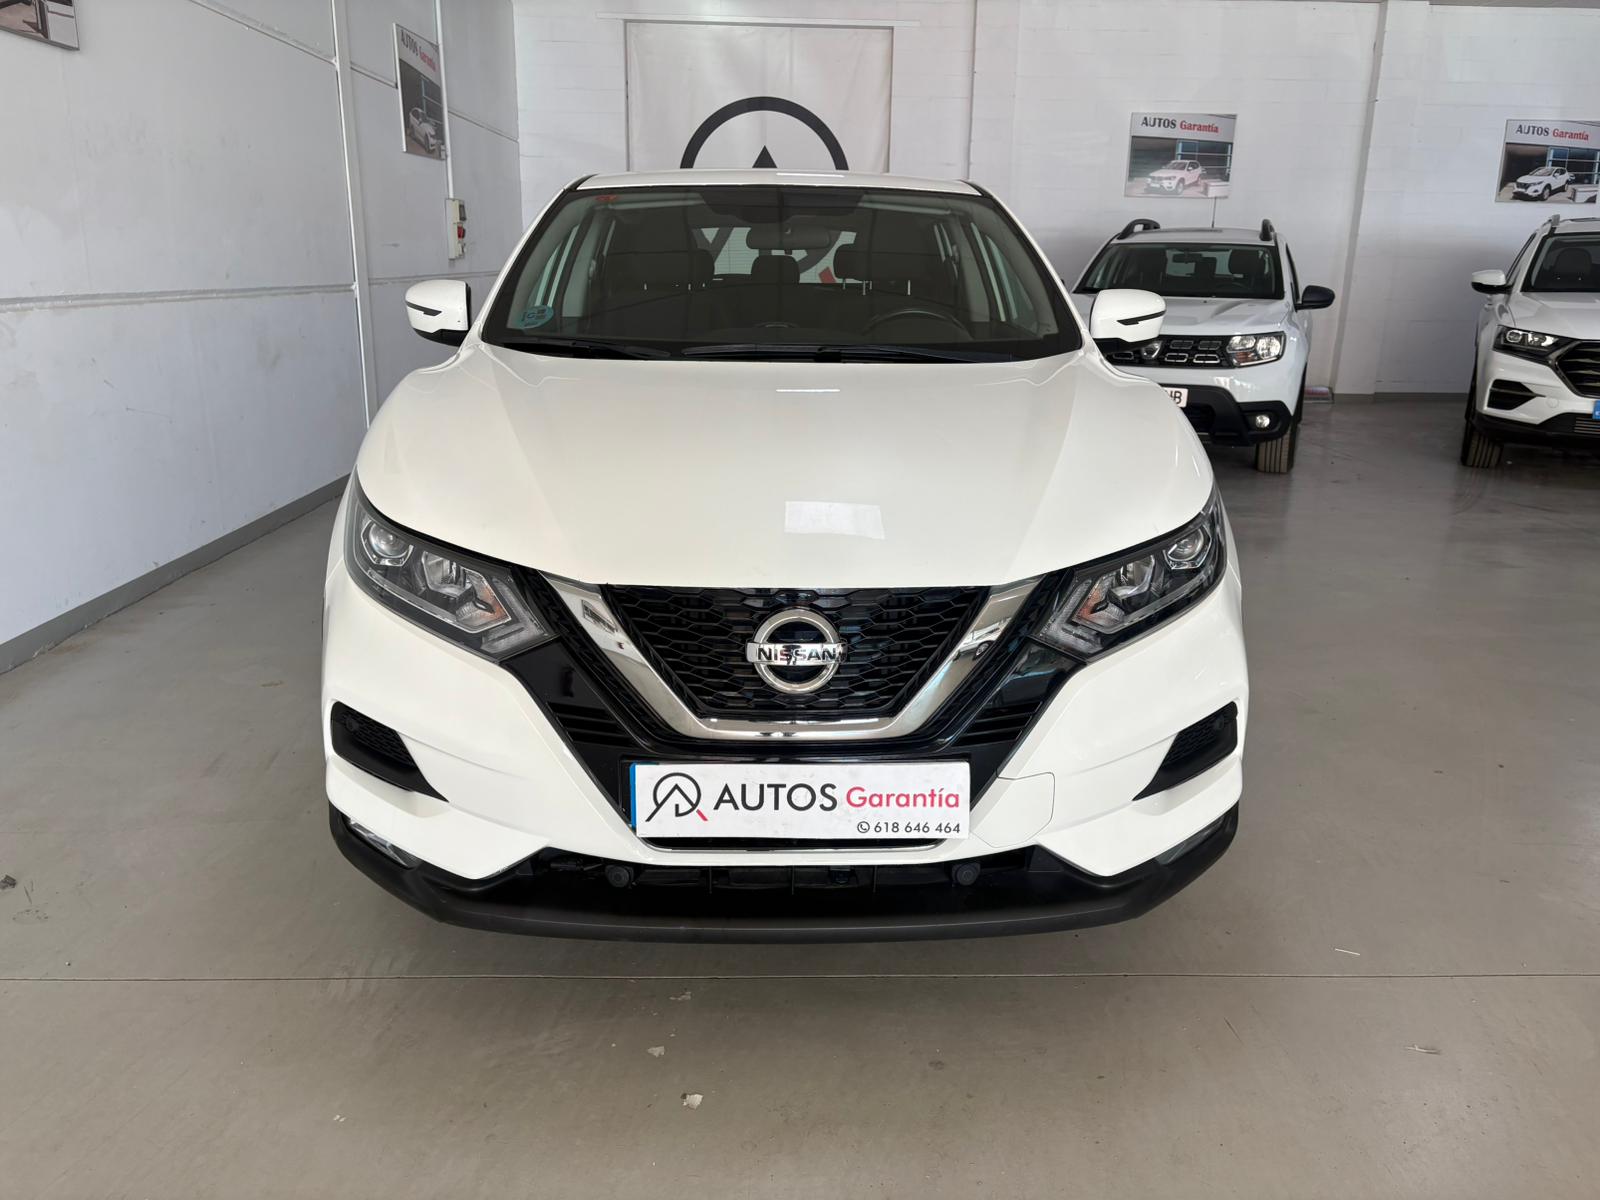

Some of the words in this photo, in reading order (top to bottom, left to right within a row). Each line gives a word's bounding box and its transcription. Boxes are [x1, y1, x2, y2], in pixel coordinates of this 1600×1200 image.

[1141, 116, 1177, 129] AUTOS
[1180, 120, 1219, 133] Garantía
[1516, 124, 1550, 137] AUTOS
[1552, 128, 1589, 141] Garantía
[757, 647, 837, 661] NISSAN
[713, 783, 838, 812] AUTOS
[846, 786, 960, 808] Garantía
[874, 821, 900, 833] 618
[904, 821, 930, 833] 646
[935, 822, 961, 834] 464
